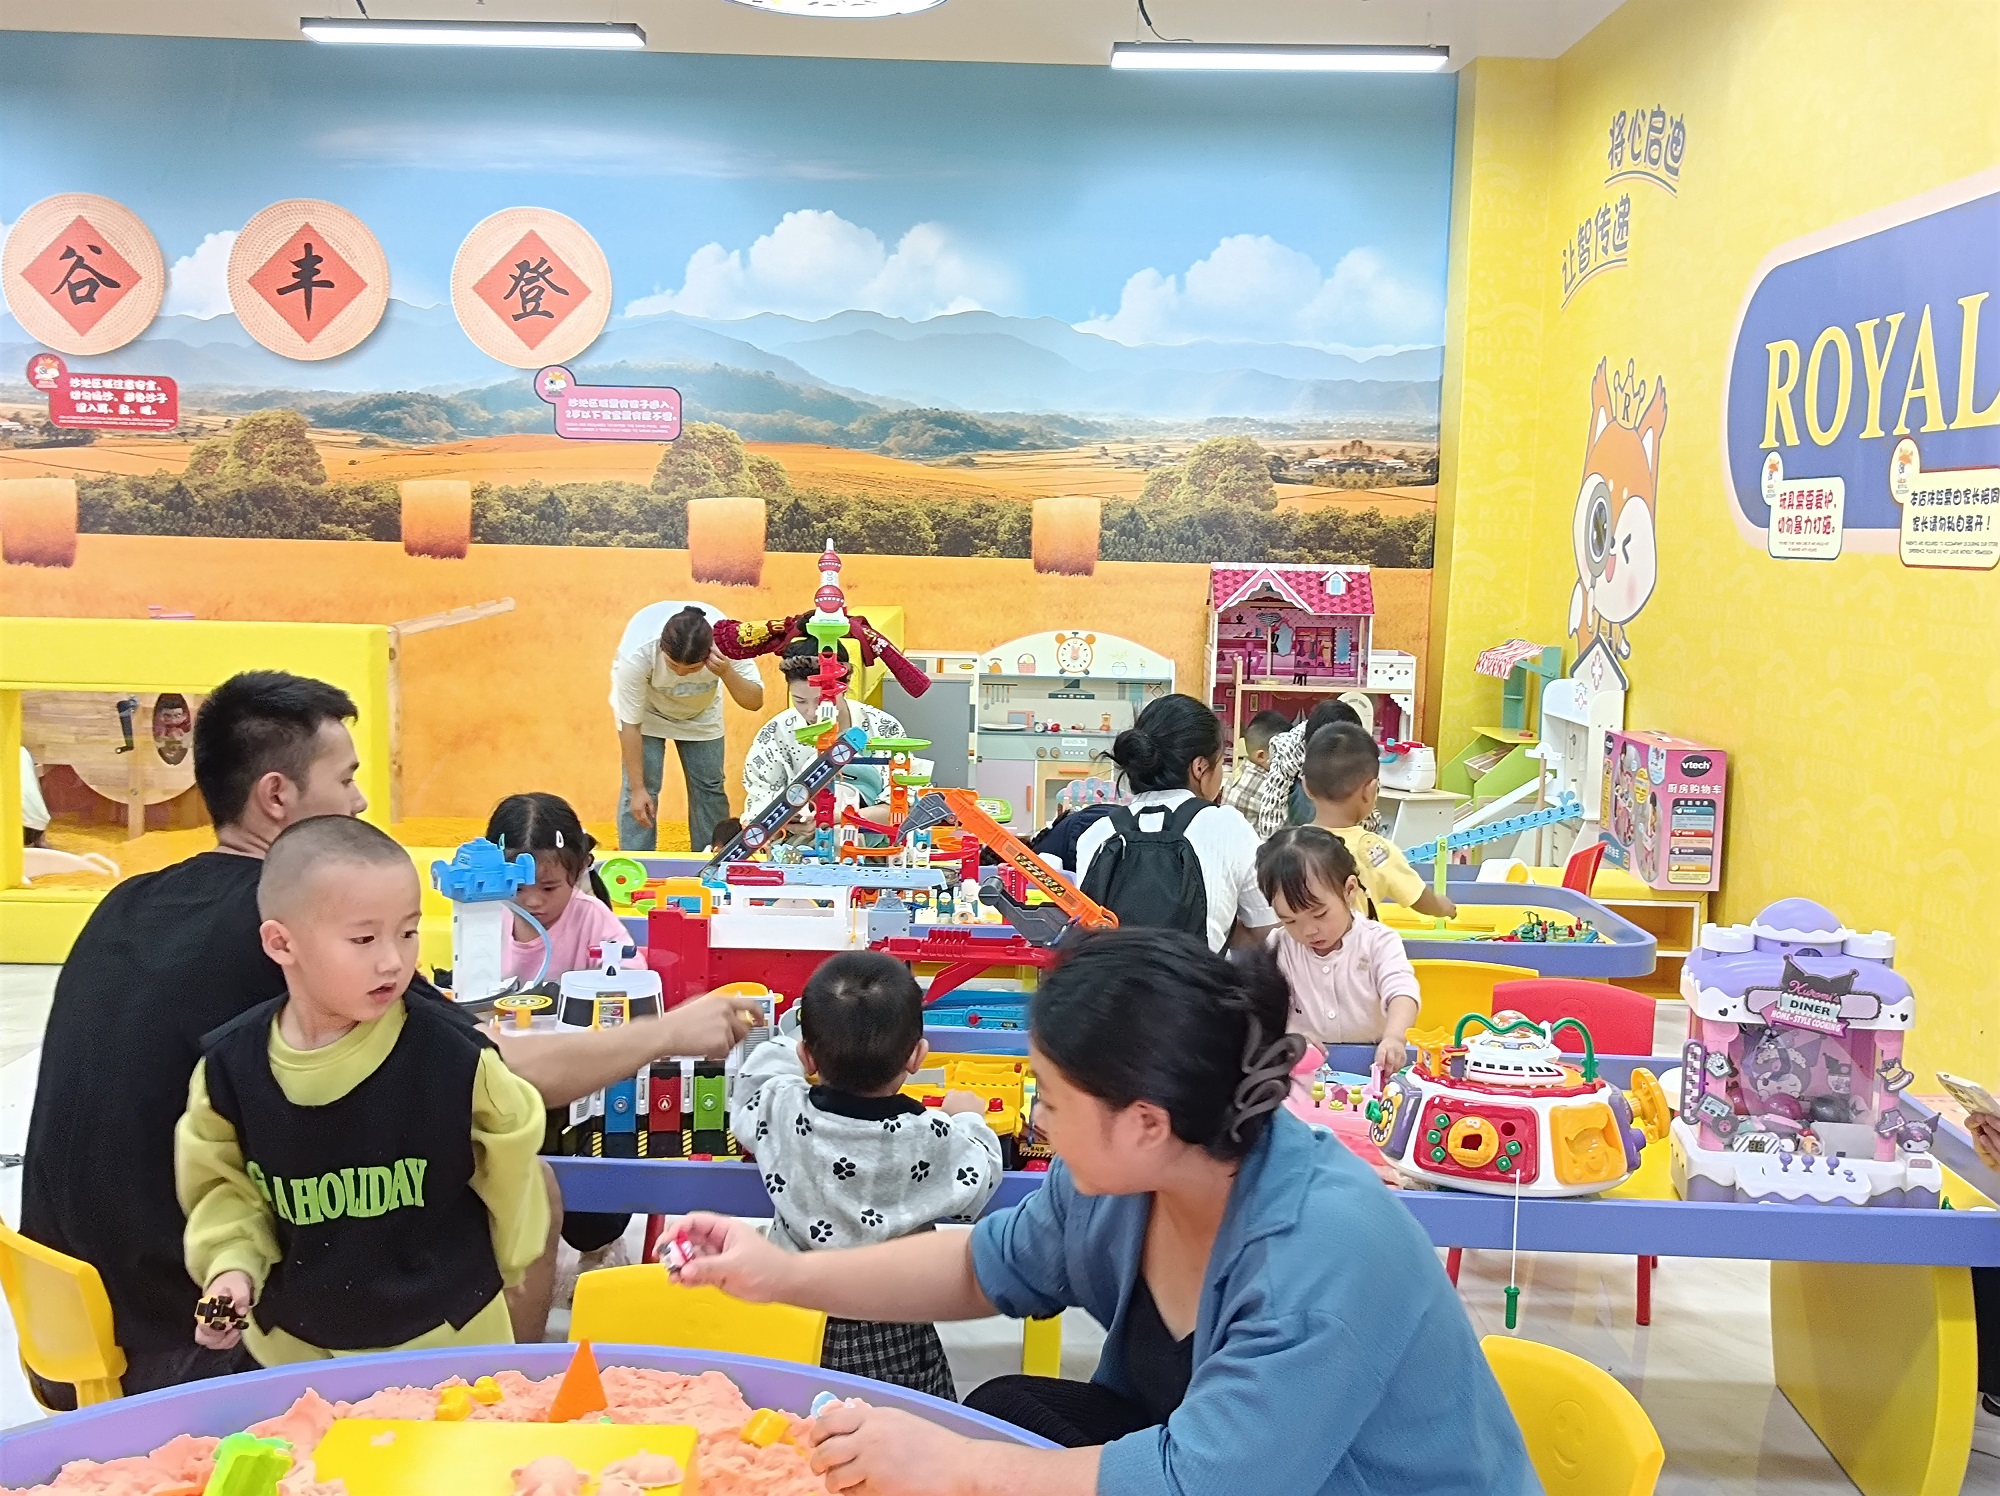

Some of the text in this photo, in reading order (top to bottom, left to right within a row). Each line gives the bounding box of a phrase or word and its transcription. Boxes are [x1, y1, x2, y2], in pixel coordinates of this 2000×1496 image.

[1608, 103, 1686, 176] 将心启迪
[50, 244, 121, 306] 谷
[1562, 193, 1630, 294] 让智传递
[276, 242, 335, 321] 丰
[503, 257, 569, 321] 登
[1759, 292, 2000, 449] ROYAL
[1667, 784, 1722, 795] 厨房购物车
[1682, 759, 1710, 769] vtech
[1789, 1000, 1830, 1016] DINER
